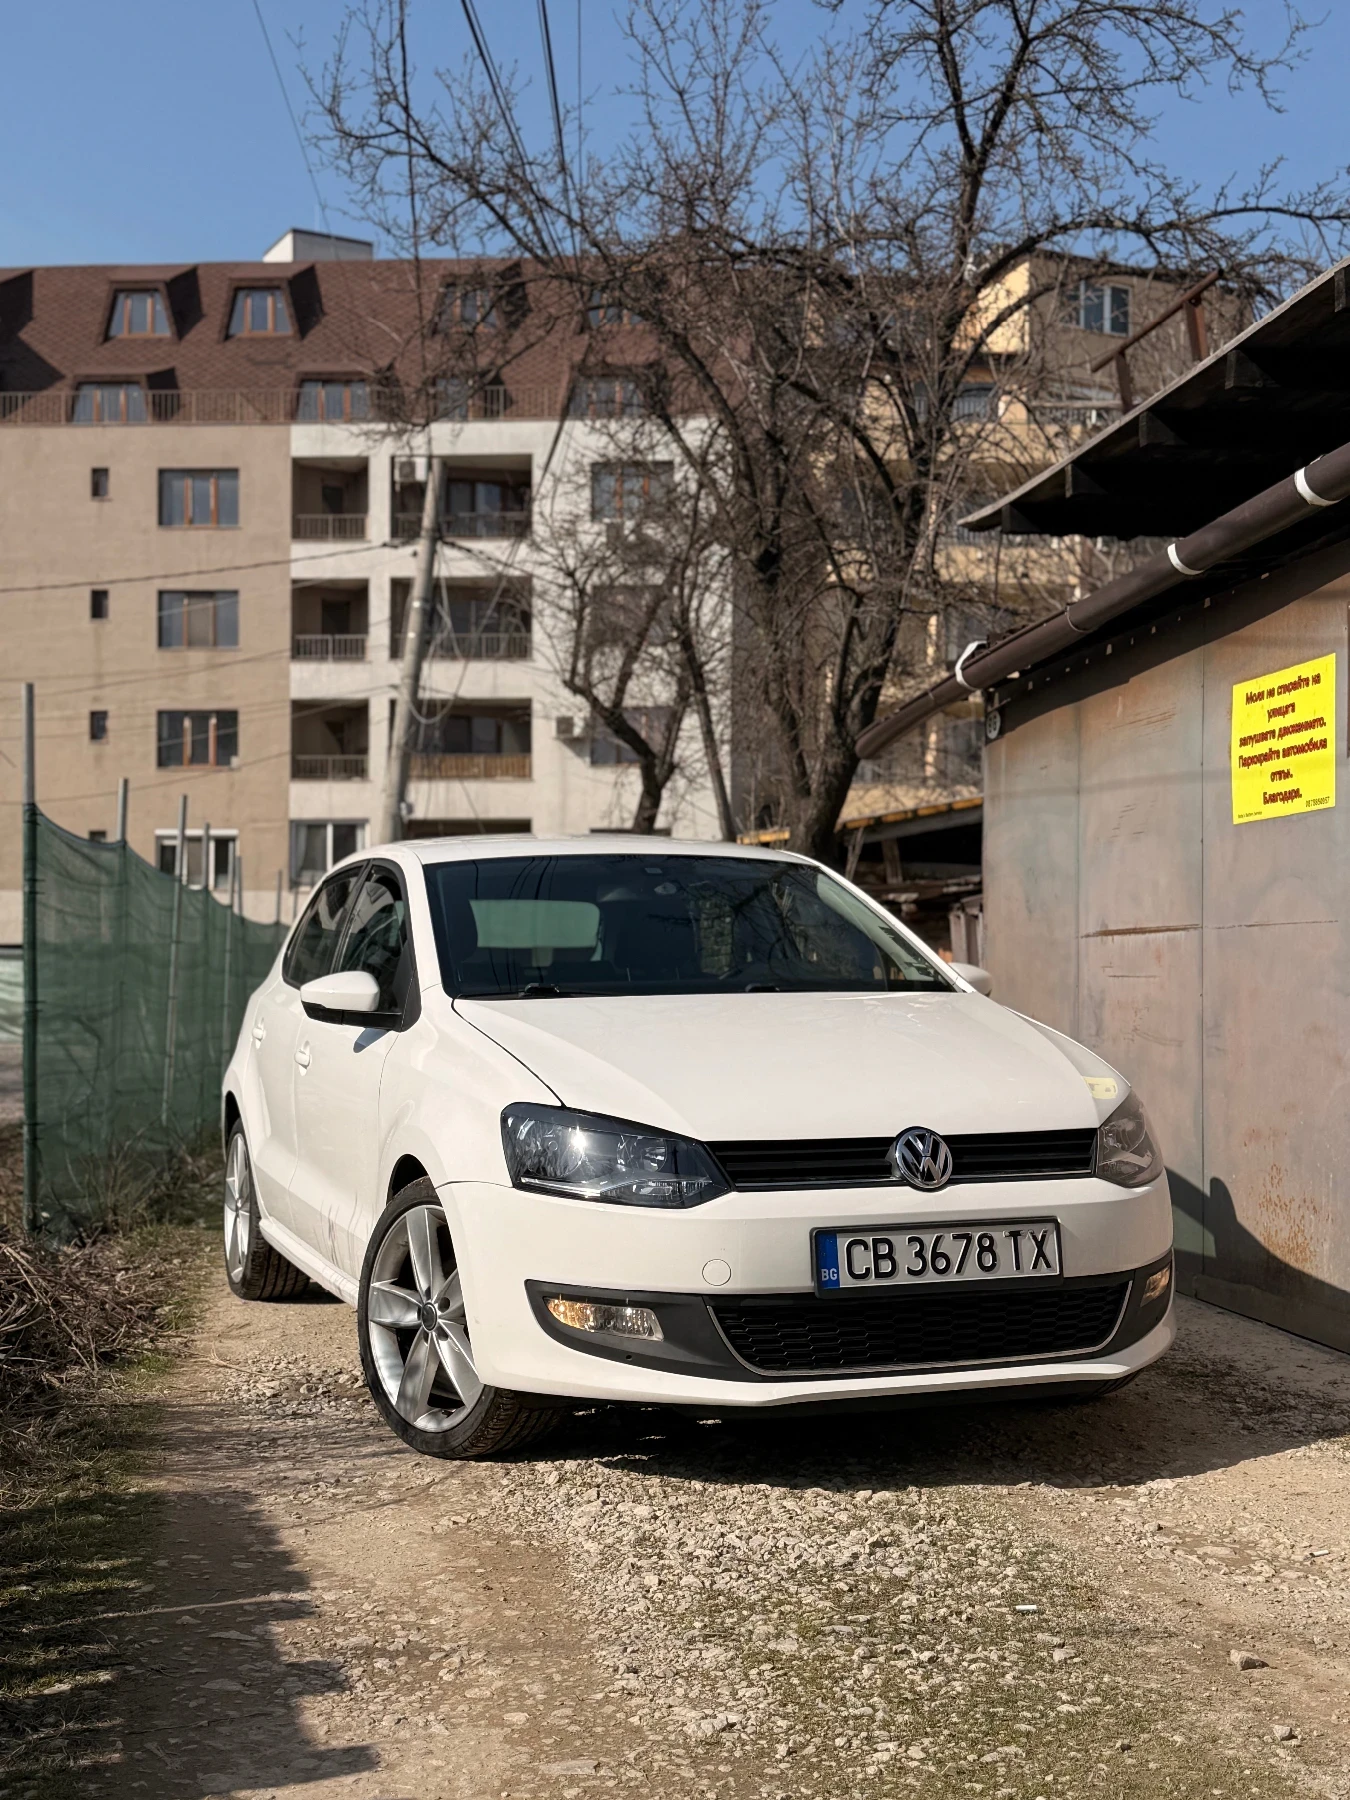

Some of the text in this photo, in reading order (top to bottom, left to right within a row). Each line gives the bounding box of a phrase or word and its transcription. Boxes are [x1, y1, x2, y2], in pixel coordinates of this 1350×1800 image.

[1245, 689, 1265, 705] Моля
[906, 1233, 998, 1276] 3678
[1003, 1229, 1052, 1271] TX
[821, 1268, 838, 1281] BG
